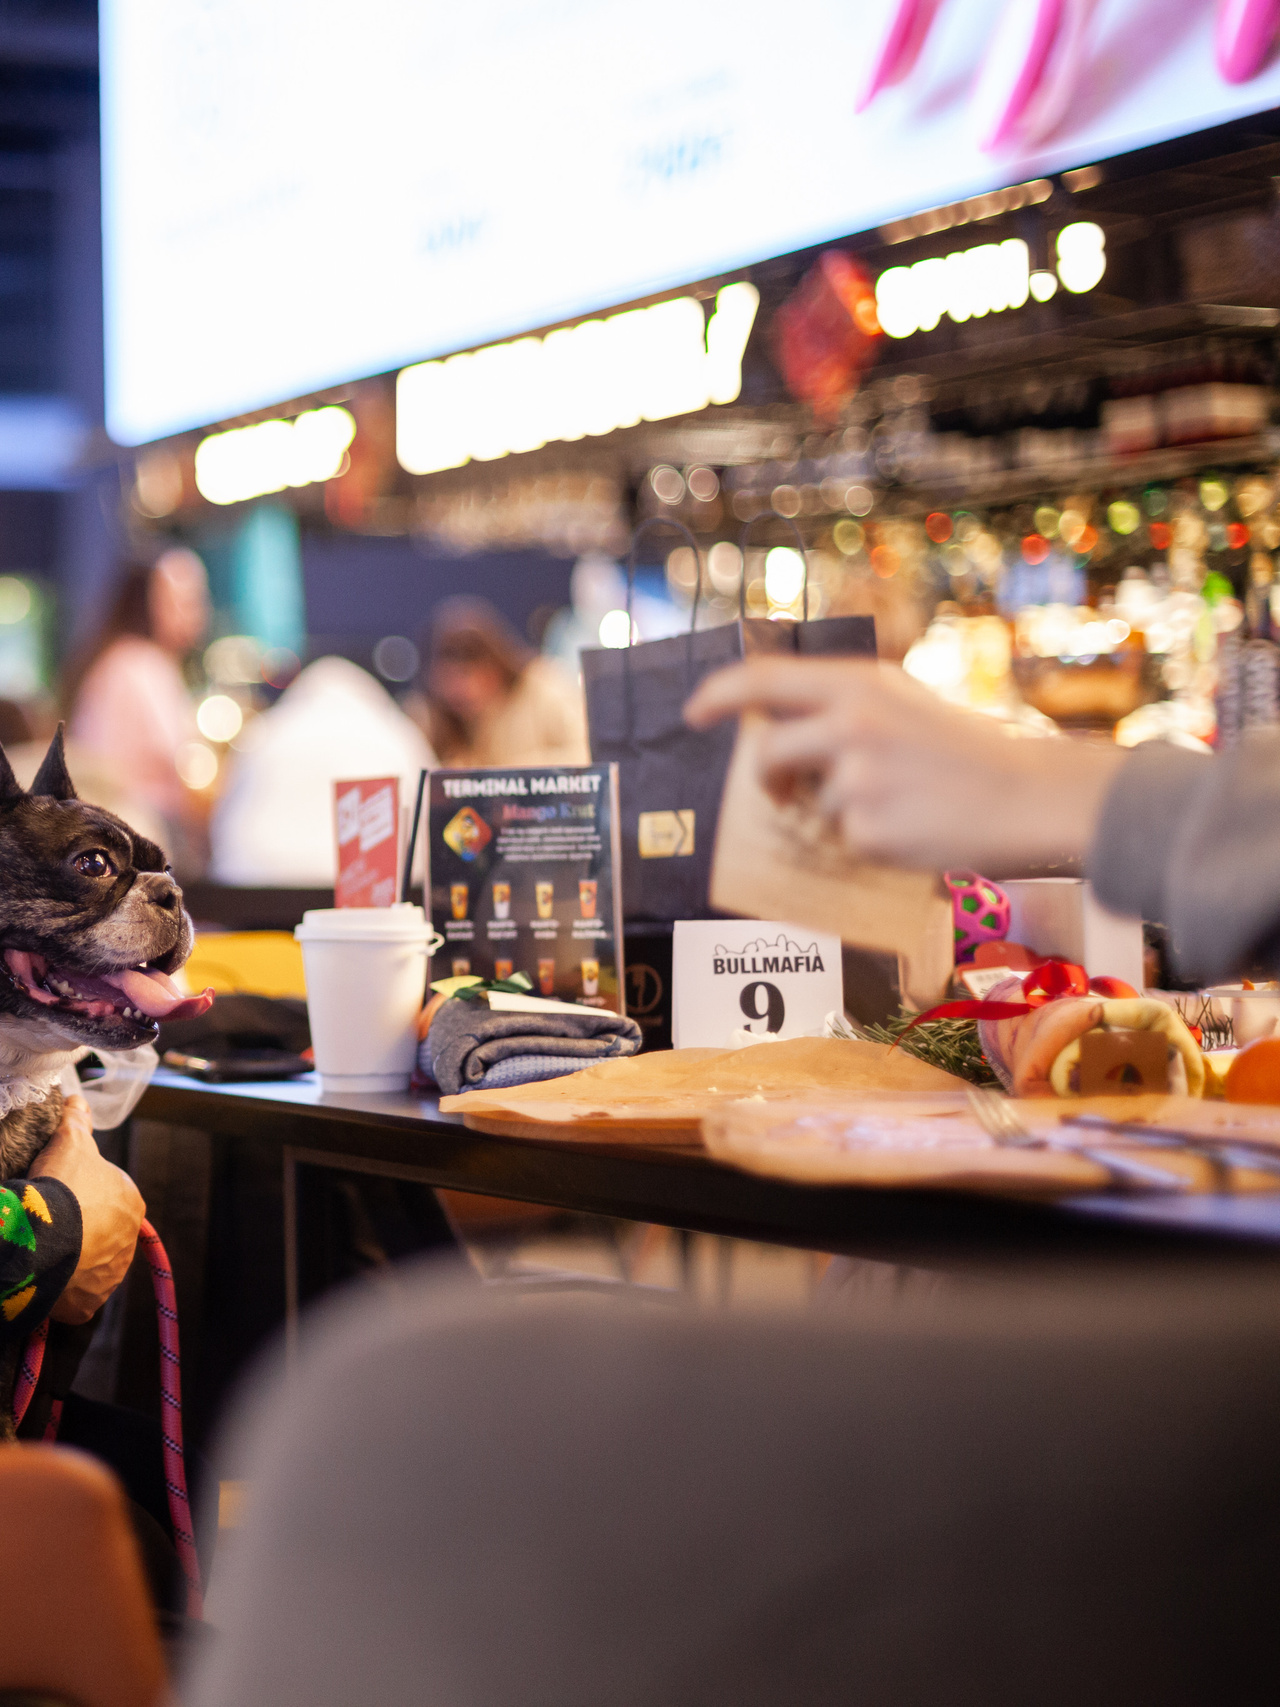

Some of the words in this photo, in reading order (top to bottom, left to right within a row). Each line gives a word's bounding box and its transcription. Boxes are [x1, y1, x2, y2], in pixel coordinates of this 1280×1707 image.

[443, 777, 528, 798] TERMINAL
[531, 775, 601, 795] MARKET
[502, 804, 557, 822] Mango
[713, 956, 825, 974] BULLMAFIA
[739, 981, 785, 1034] 9
